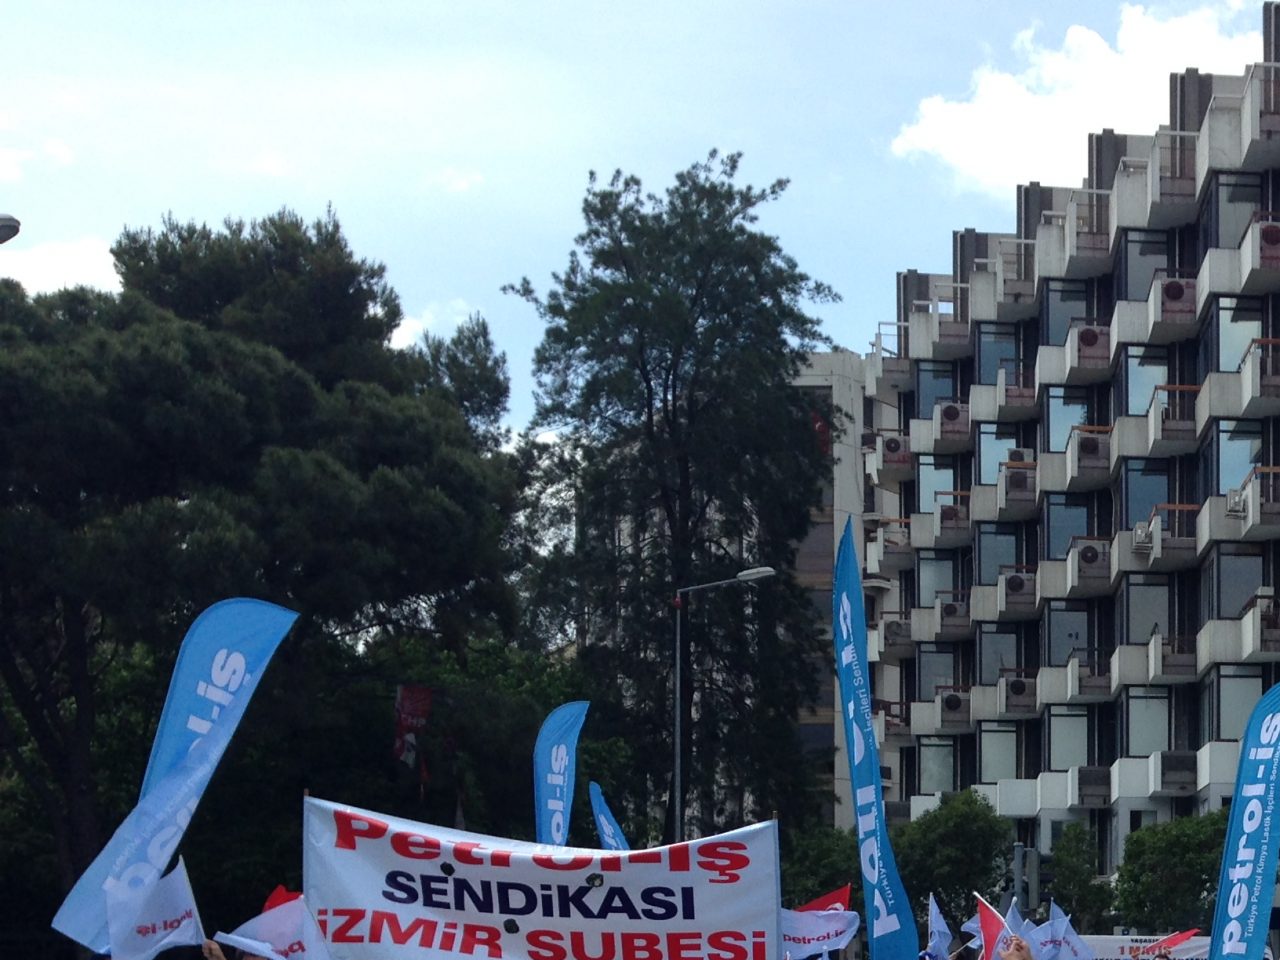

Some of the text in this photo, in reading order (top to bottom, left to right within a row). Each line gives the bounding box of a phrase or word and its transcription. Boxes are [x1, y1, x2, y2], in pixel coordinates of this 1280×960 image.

[547, 743, 569, 844] ol-iş
[1251, 875, 1263, 903] Petrol
[1245, 904, 1258, 937] Türkiye
